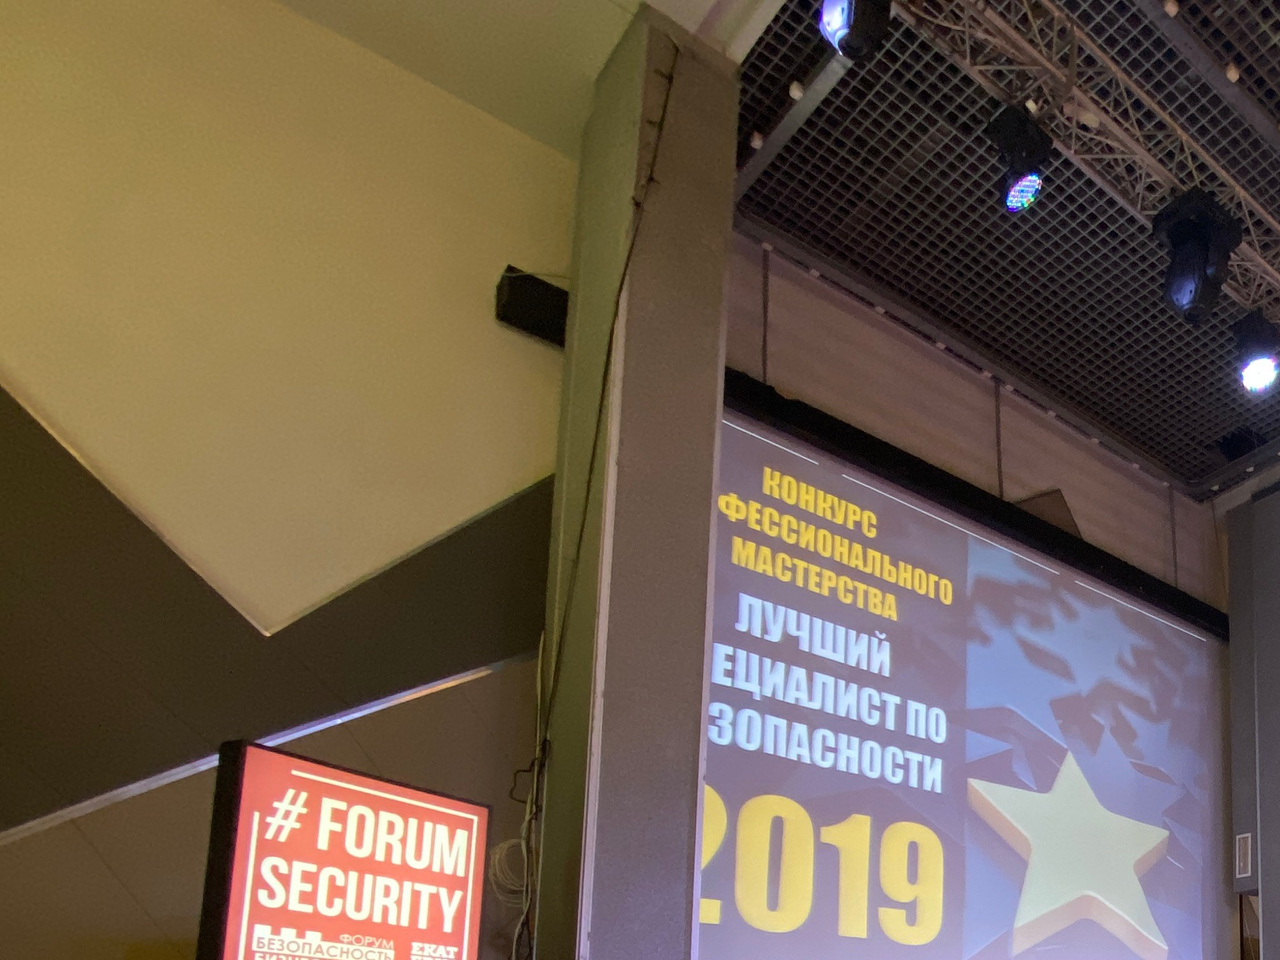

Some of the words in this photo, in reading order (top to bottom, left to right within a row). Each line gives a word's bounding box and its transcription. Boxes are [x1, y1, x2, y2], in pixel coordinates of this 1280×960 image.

[762, 466, 877, 538] КОНКУРС
[717, 492, 953, 605] ФЕССИОНАЛЬНОГО
[731, 536, 897, 621] МАСТЕРСТВА
[734, 592, 890, 677] ЛУЧШИЙ
[711, 642, 901, 731] ЕЦИАЛИСТ
[906, 700, 947, 744] ПО
[707, 702, 943, 793] ЗОПАСНОСТИ
[316, 797, 469, 877] FORUM
[257, 856, 463, 933] SECURITY
[339, 933, 394, 950] ФОРУМ
[411, 942, 458, 959] EKAT
